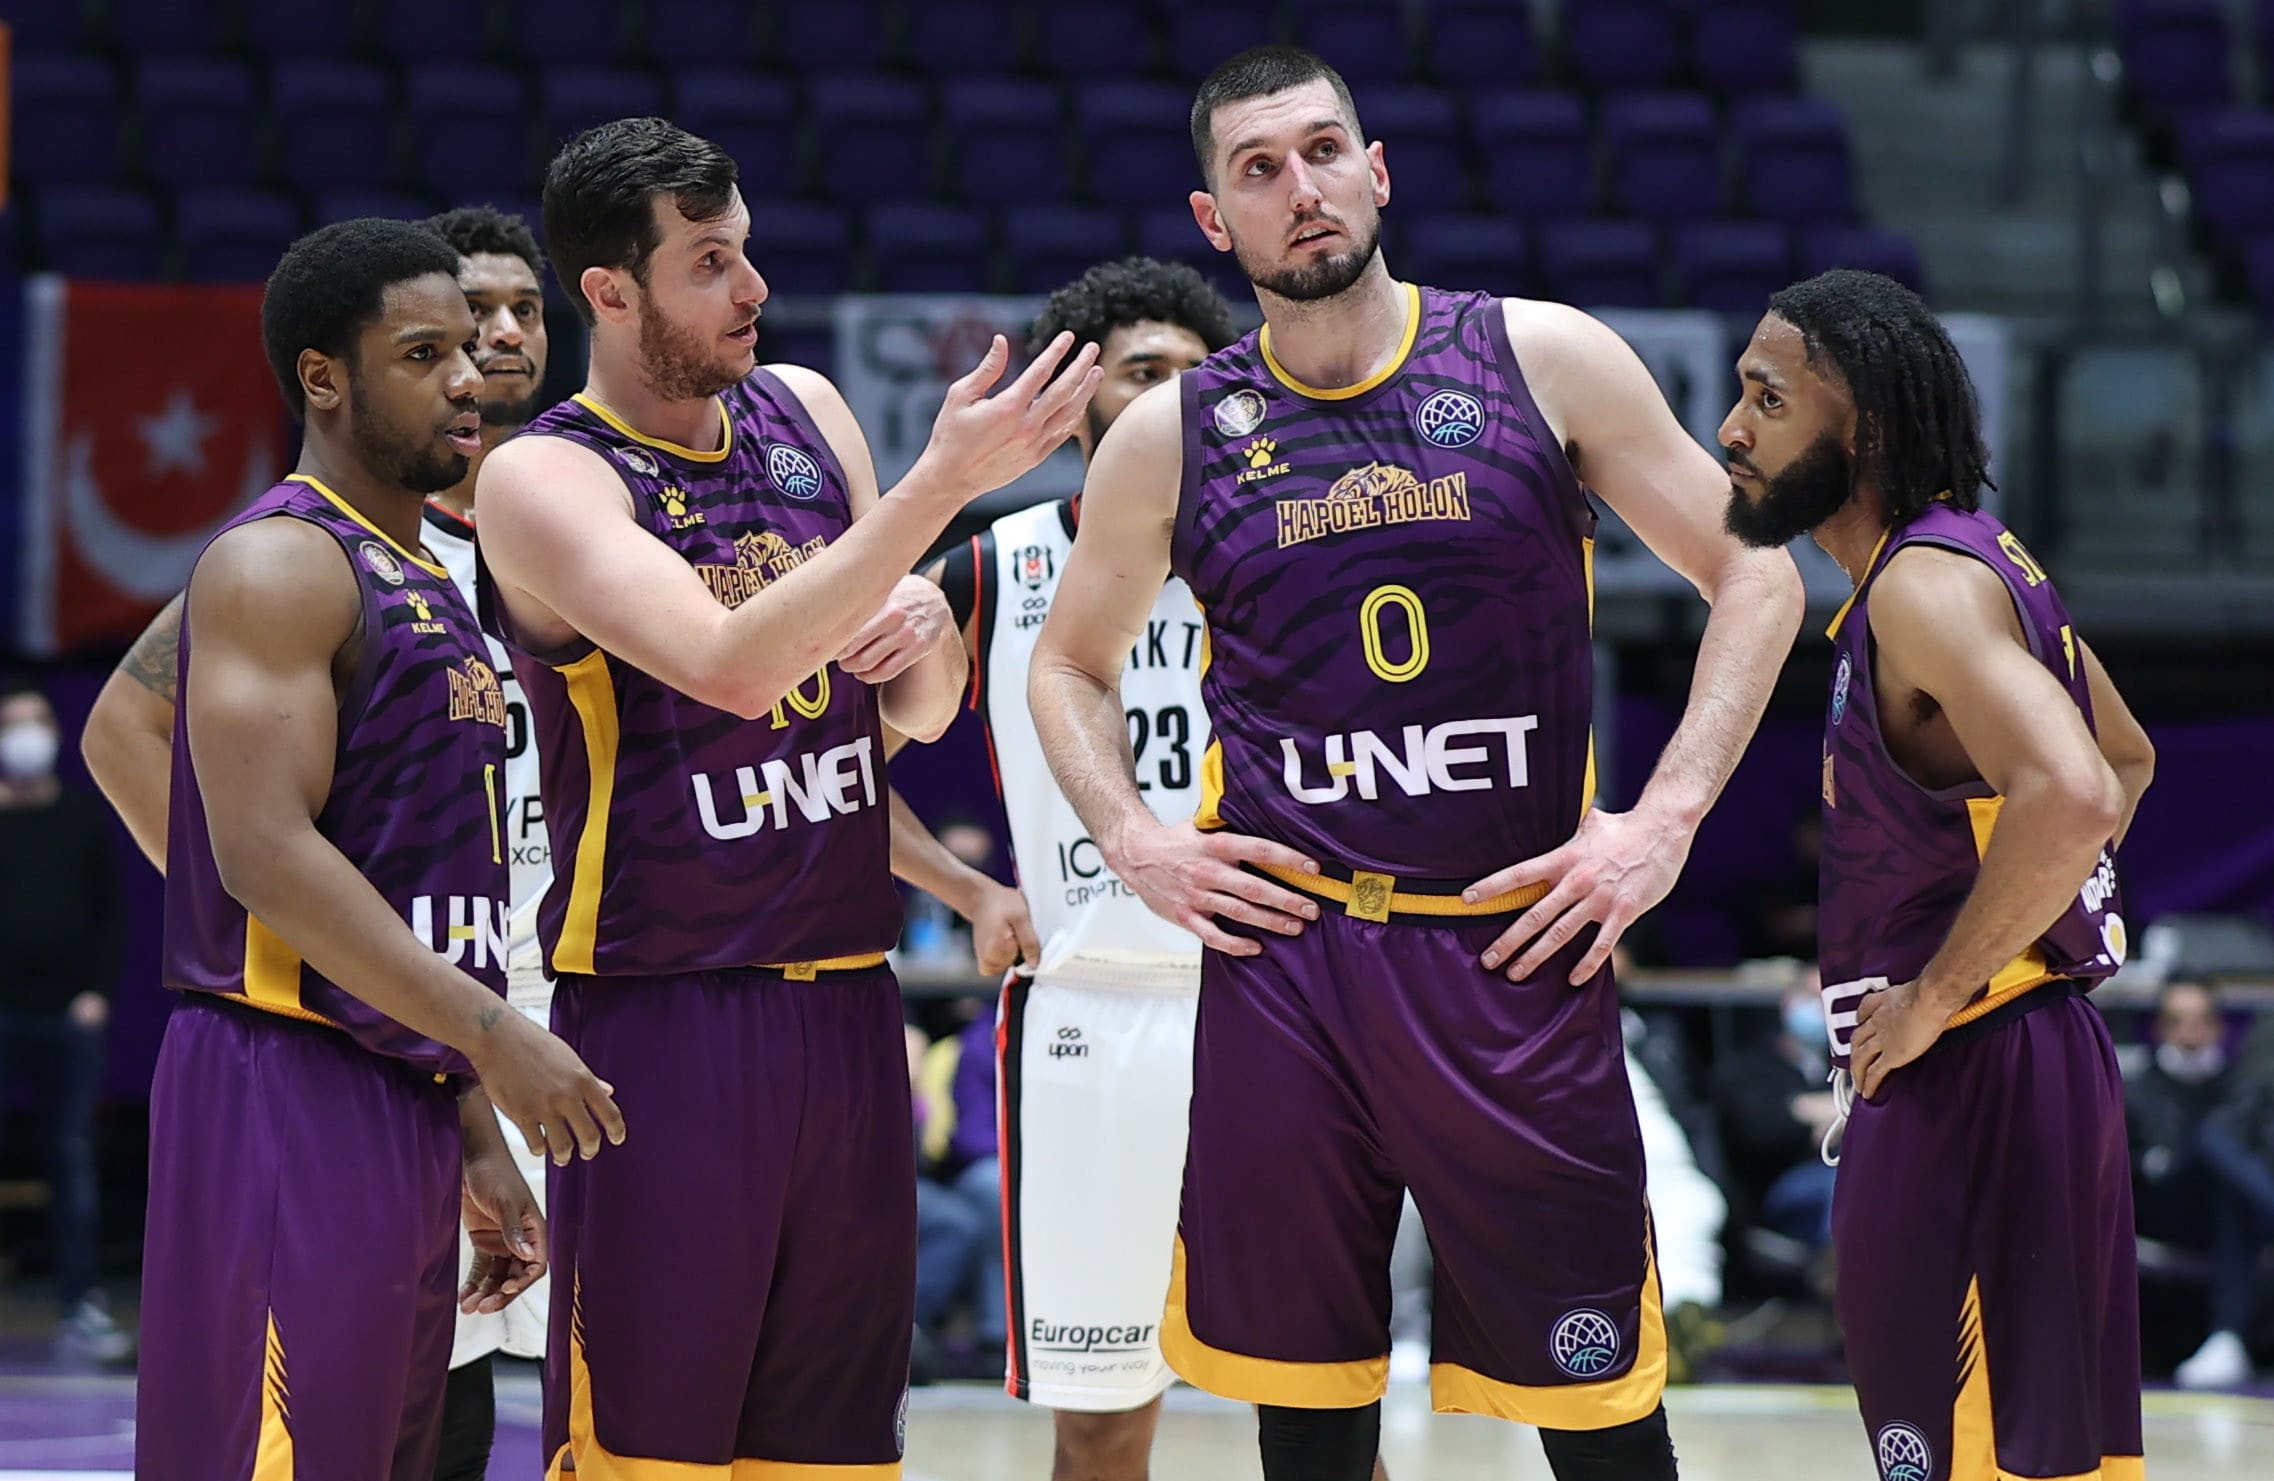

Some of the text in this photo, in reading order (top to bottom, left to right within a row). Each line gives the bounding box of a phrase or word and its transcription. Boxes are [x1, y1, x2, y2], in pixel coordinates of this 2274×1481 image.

[1237, 462, 1291, 485] KELME
[1276, 470, 1472, 550] HAPOEL HOLON
[411, 622, 447, 635] KELME
[1359, 583, 1430, 683] 0
[1125, 705, 1191, 791] 23
[1048, 1043, 1089, 1060] upon
[1031, 1317, 1154, 1352] Europcar
[1081, 1362, 1118, 1374] your
